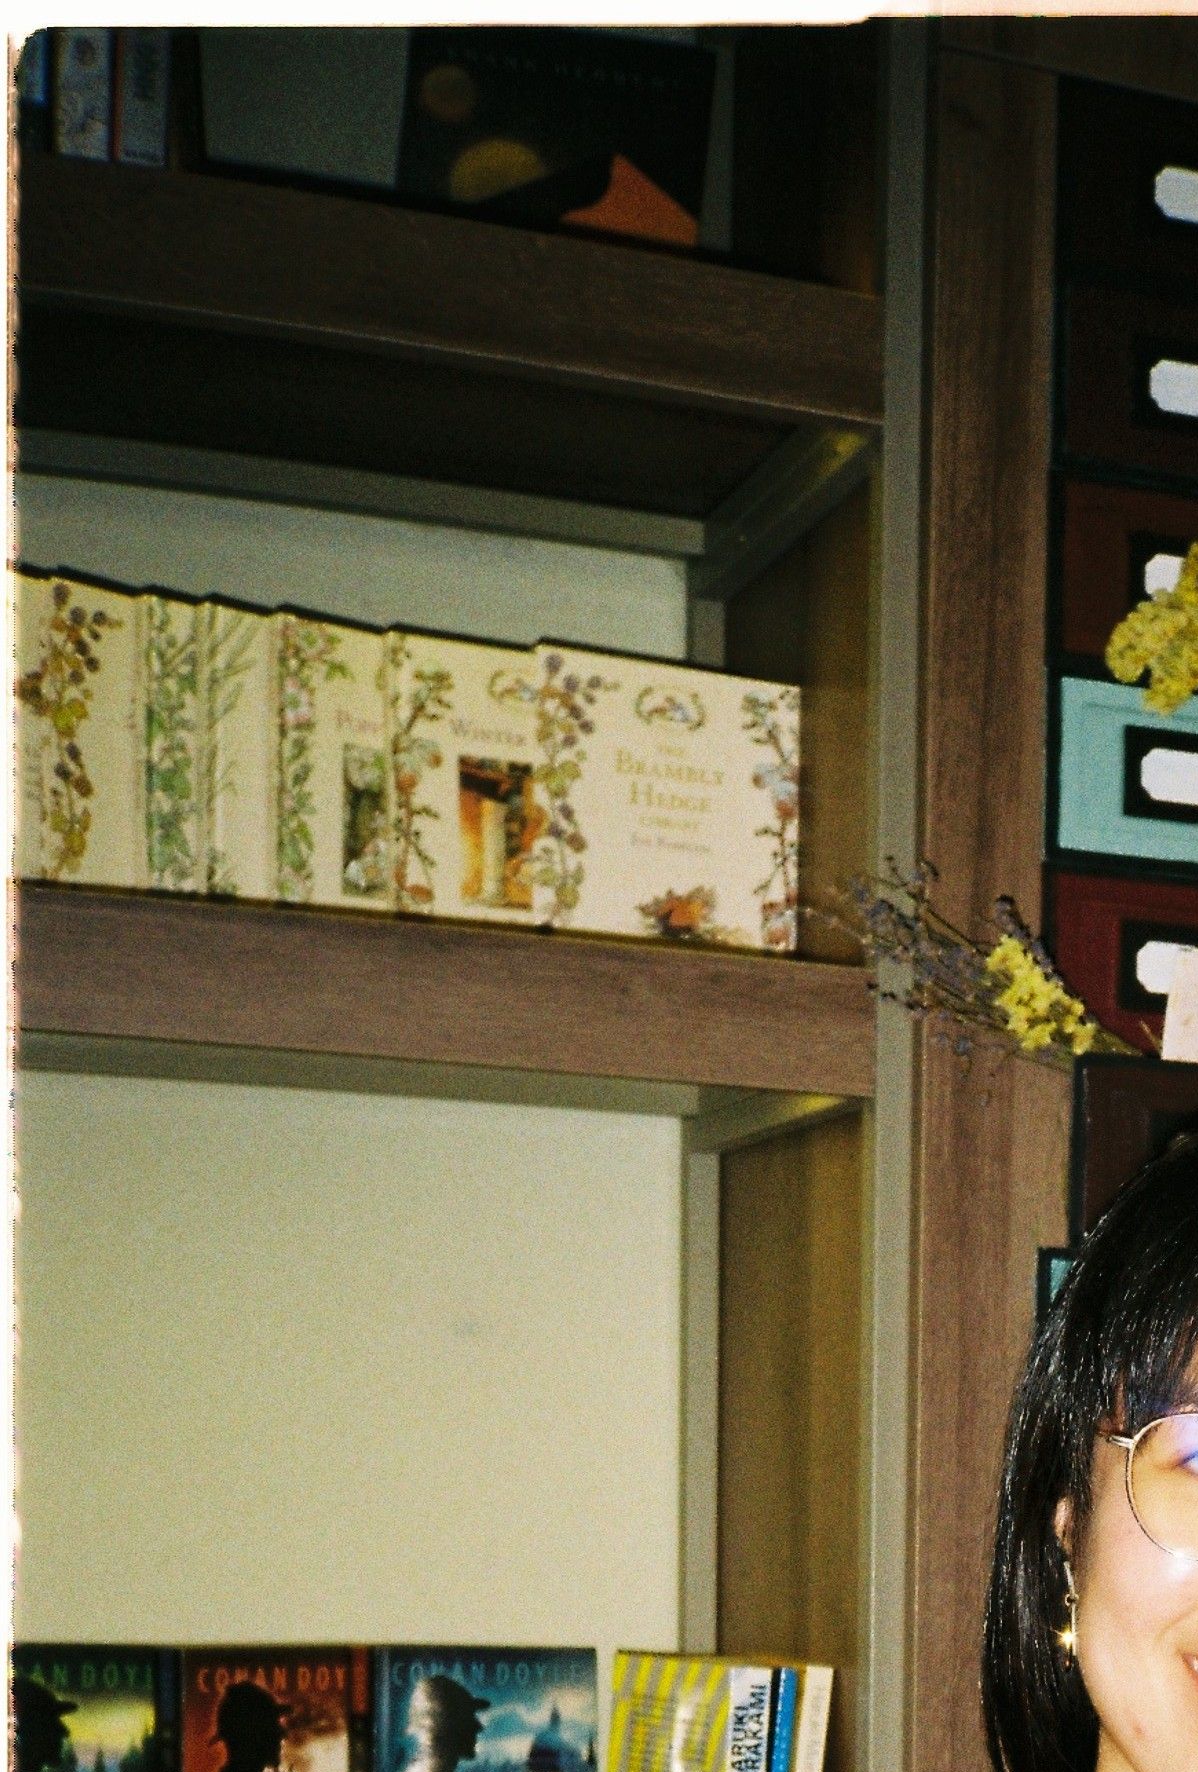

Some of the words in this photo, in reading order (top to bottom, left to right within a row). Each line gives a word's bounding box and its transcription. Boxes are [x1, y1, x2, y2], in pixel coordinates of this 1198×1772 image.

[629, 781, 712, 813] HEDGE
[196, 1666, 288, 1693] CONAN
[392, 1661, 485, 1686] CONAN
